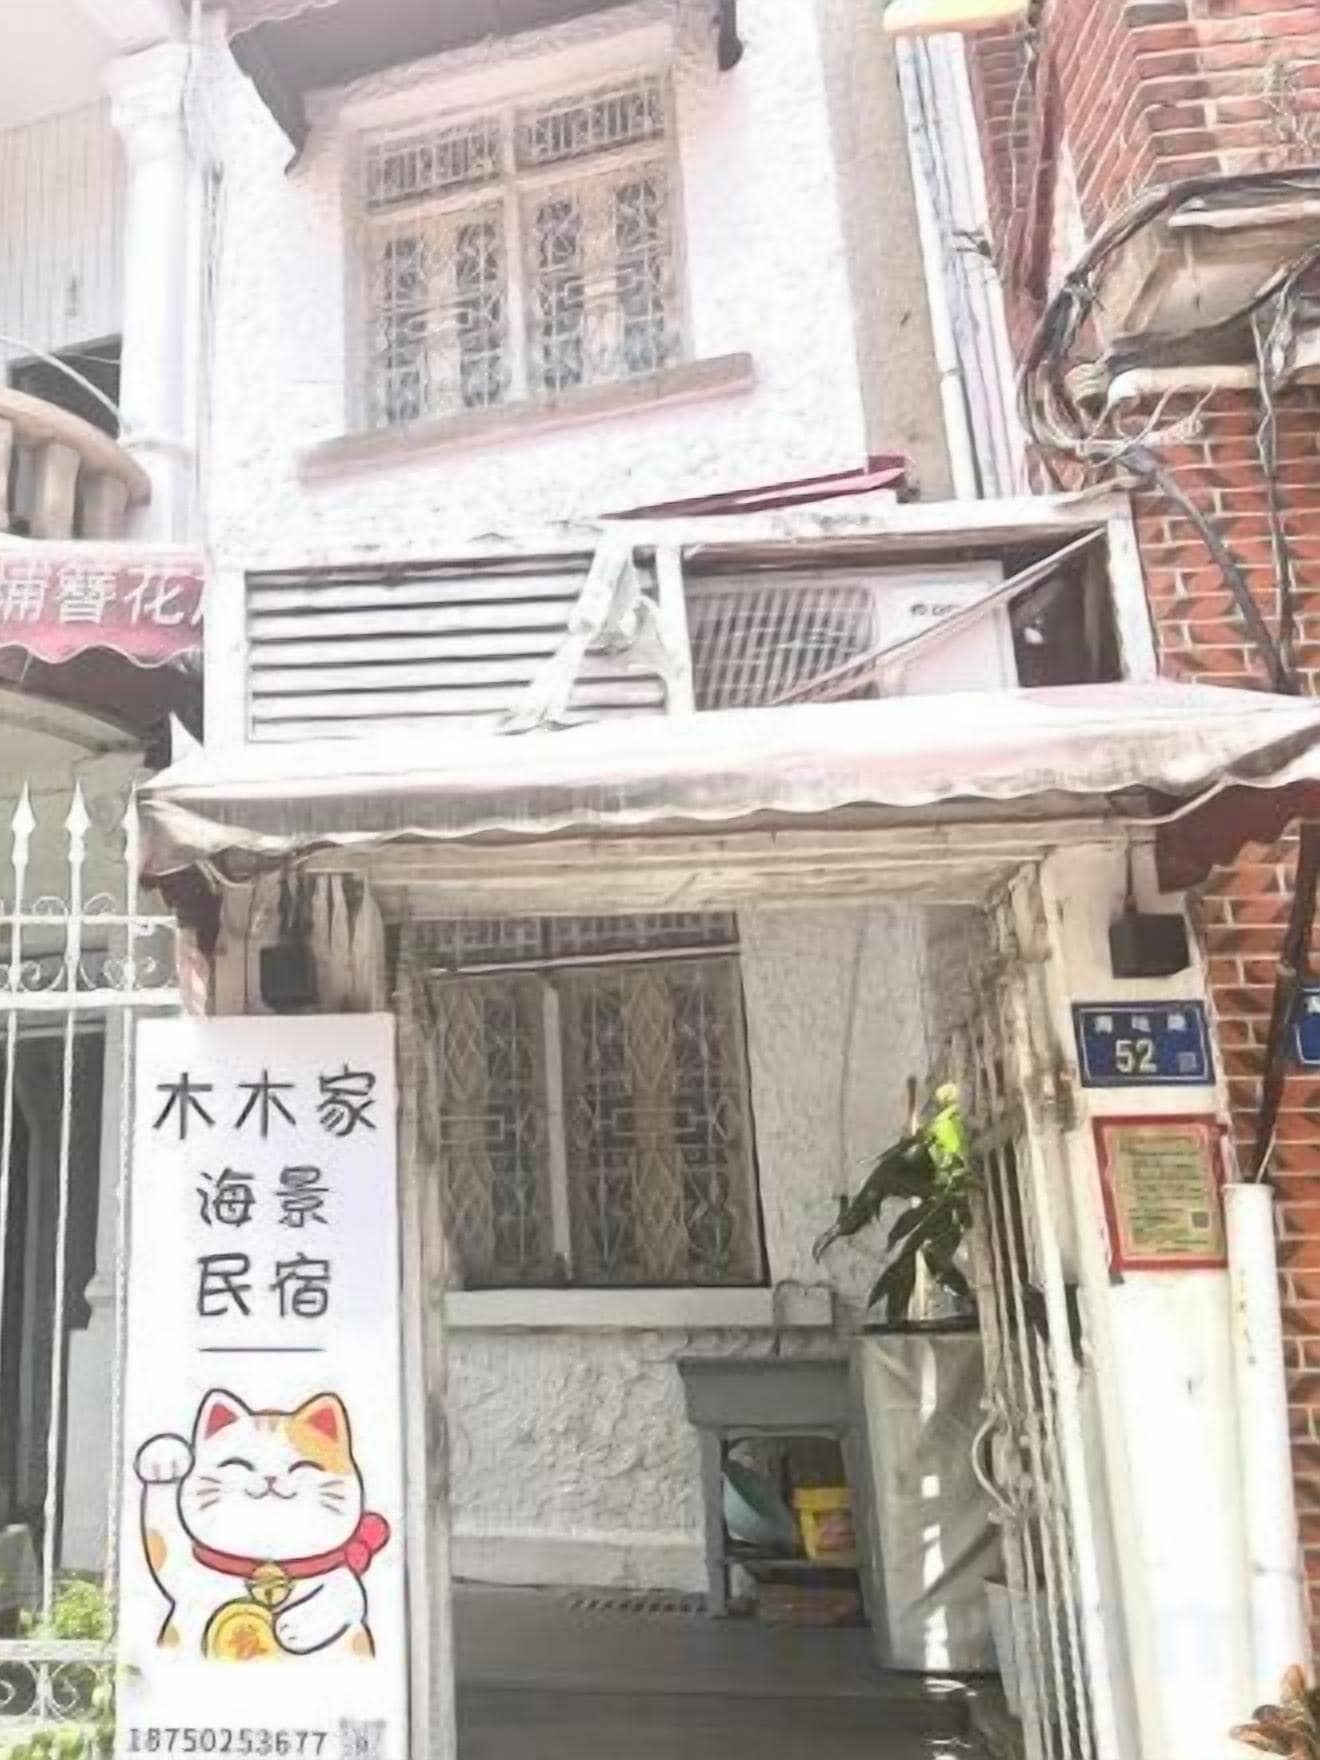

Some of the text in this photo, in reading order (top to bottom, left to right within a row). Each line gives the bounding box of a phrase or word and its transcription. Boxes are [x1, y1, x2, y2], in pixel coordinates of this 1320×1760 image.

[1115, 1038, 1157, 1074] 52
[152, 1063, 377, 1140] 木木家
[196, 1166, 334, 1228] 海景
[197, 1252, 332, 1319] 民宿
[127, 1727, 328, 1756] 18750253677
